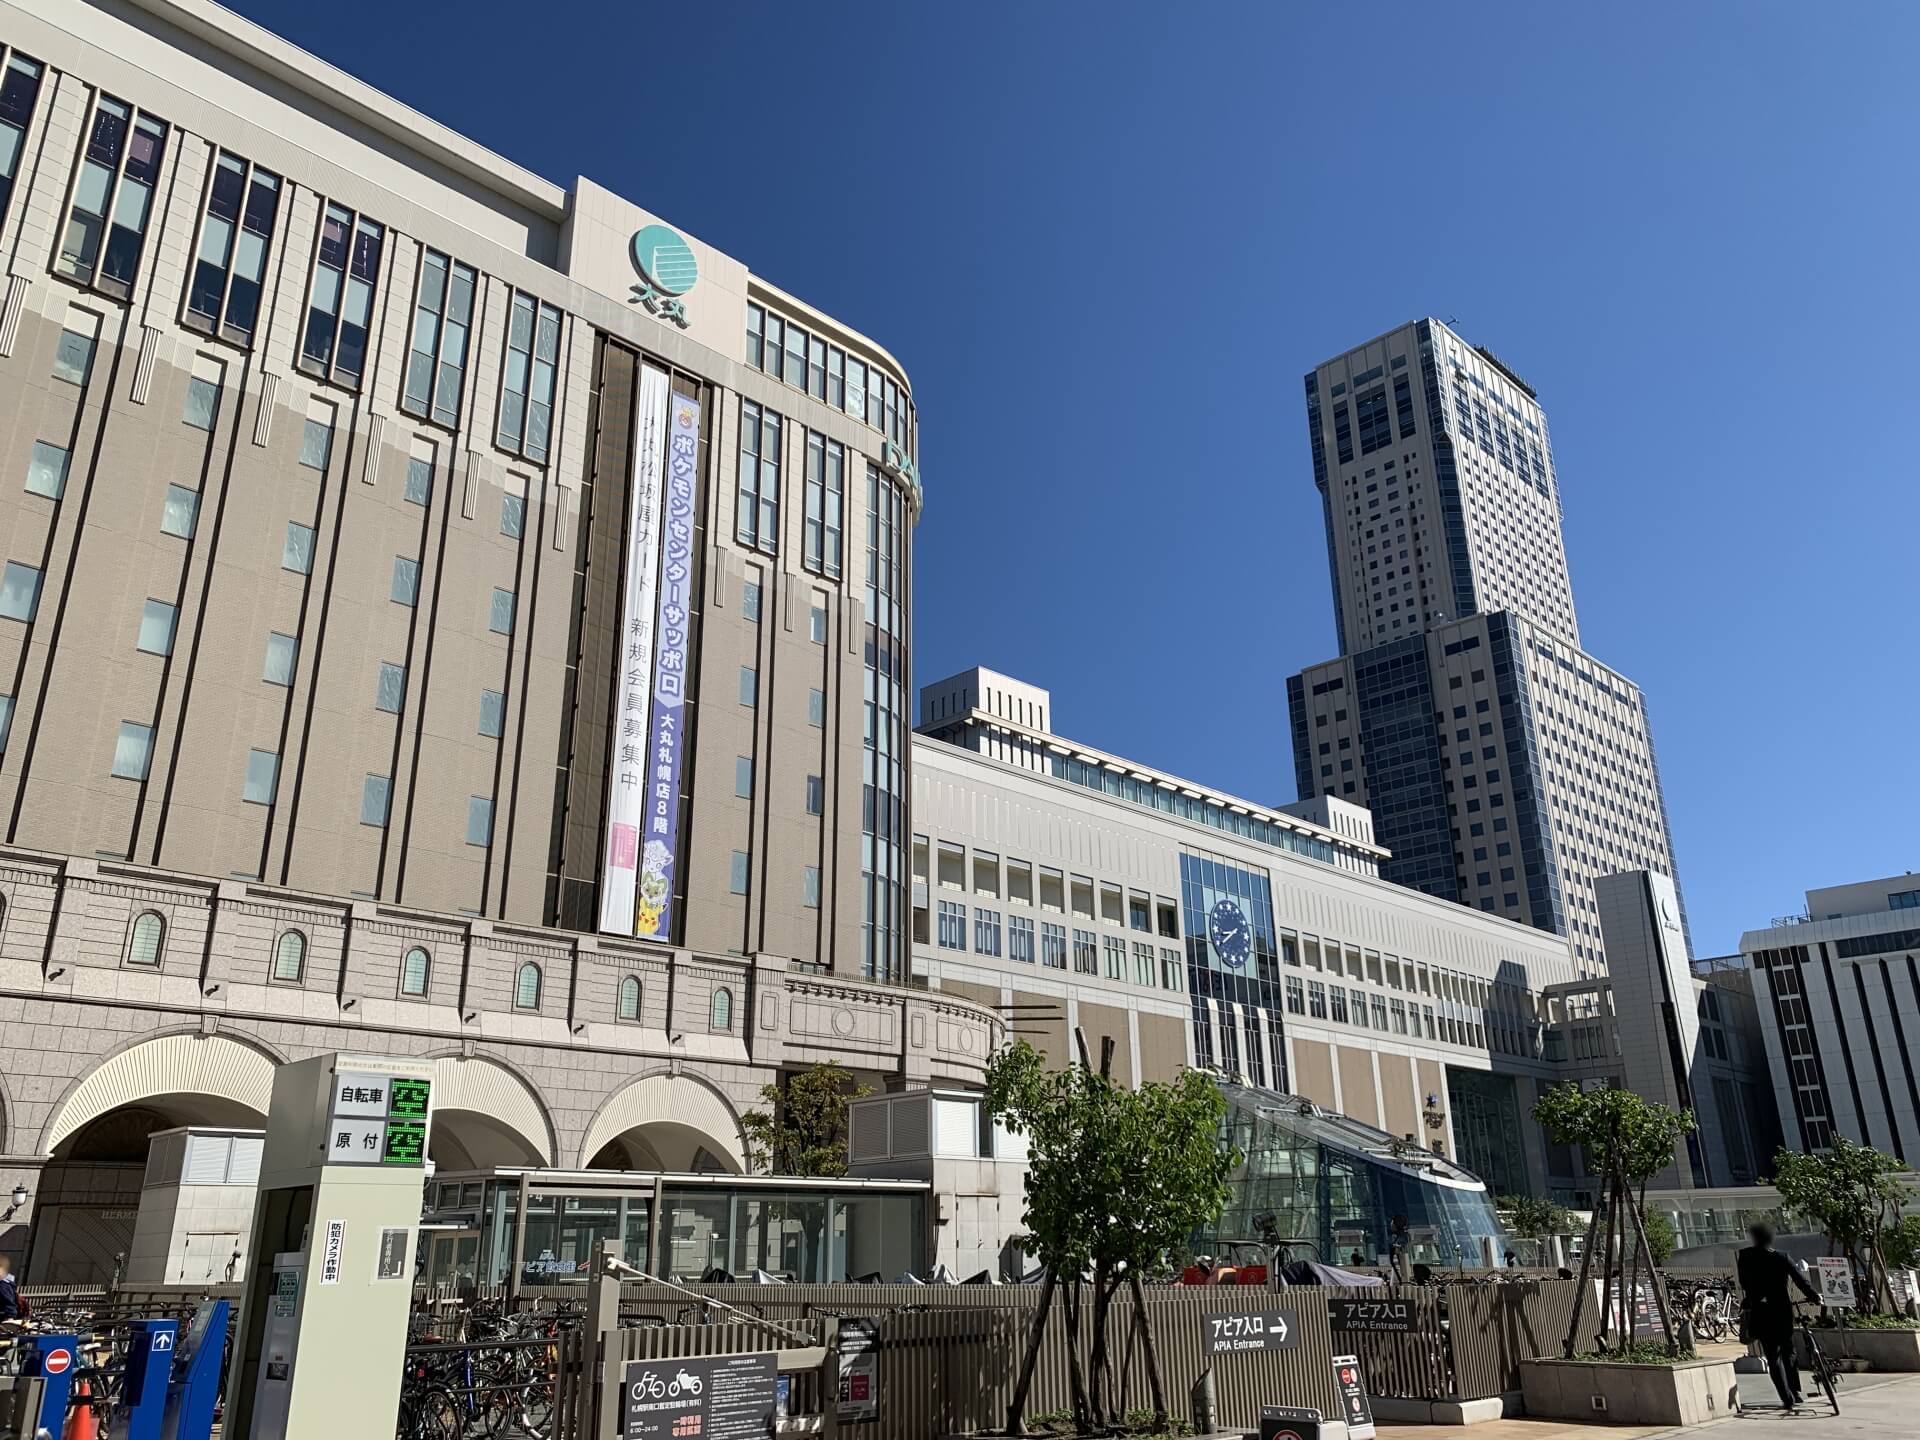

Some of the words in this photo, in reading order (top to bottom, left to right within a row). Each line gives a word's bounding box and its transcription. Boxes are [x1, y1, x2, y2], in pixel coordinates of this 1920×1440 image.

[629, 283, 694, 328] 大丸
[660, 435, 695, 696] ポケモンセンターサッポロ
[621, 618, 649, 791] 新規会員募集中
[653, 713, 676, 834] 大丸札幌店8階
[341, 1086, 384, 1104] 自転車
[389, 1077, 430, 1118] 空
[384, 1122, 425, 1163] 空
[325, 1223, 341, 1281] 防犯カメラ作動中
[1211, 1316, 1264, 1338] アピア入口
[1343, 1302, 1407, 1319] アピア入口
[1346, 1320, 1367, 1329] APIA
[1369, 1321, 1408, 1330] Entrance
[1213, 1340, 1232, 1352] APIA
[1233, 1339, 1265, 1350] Entrance
